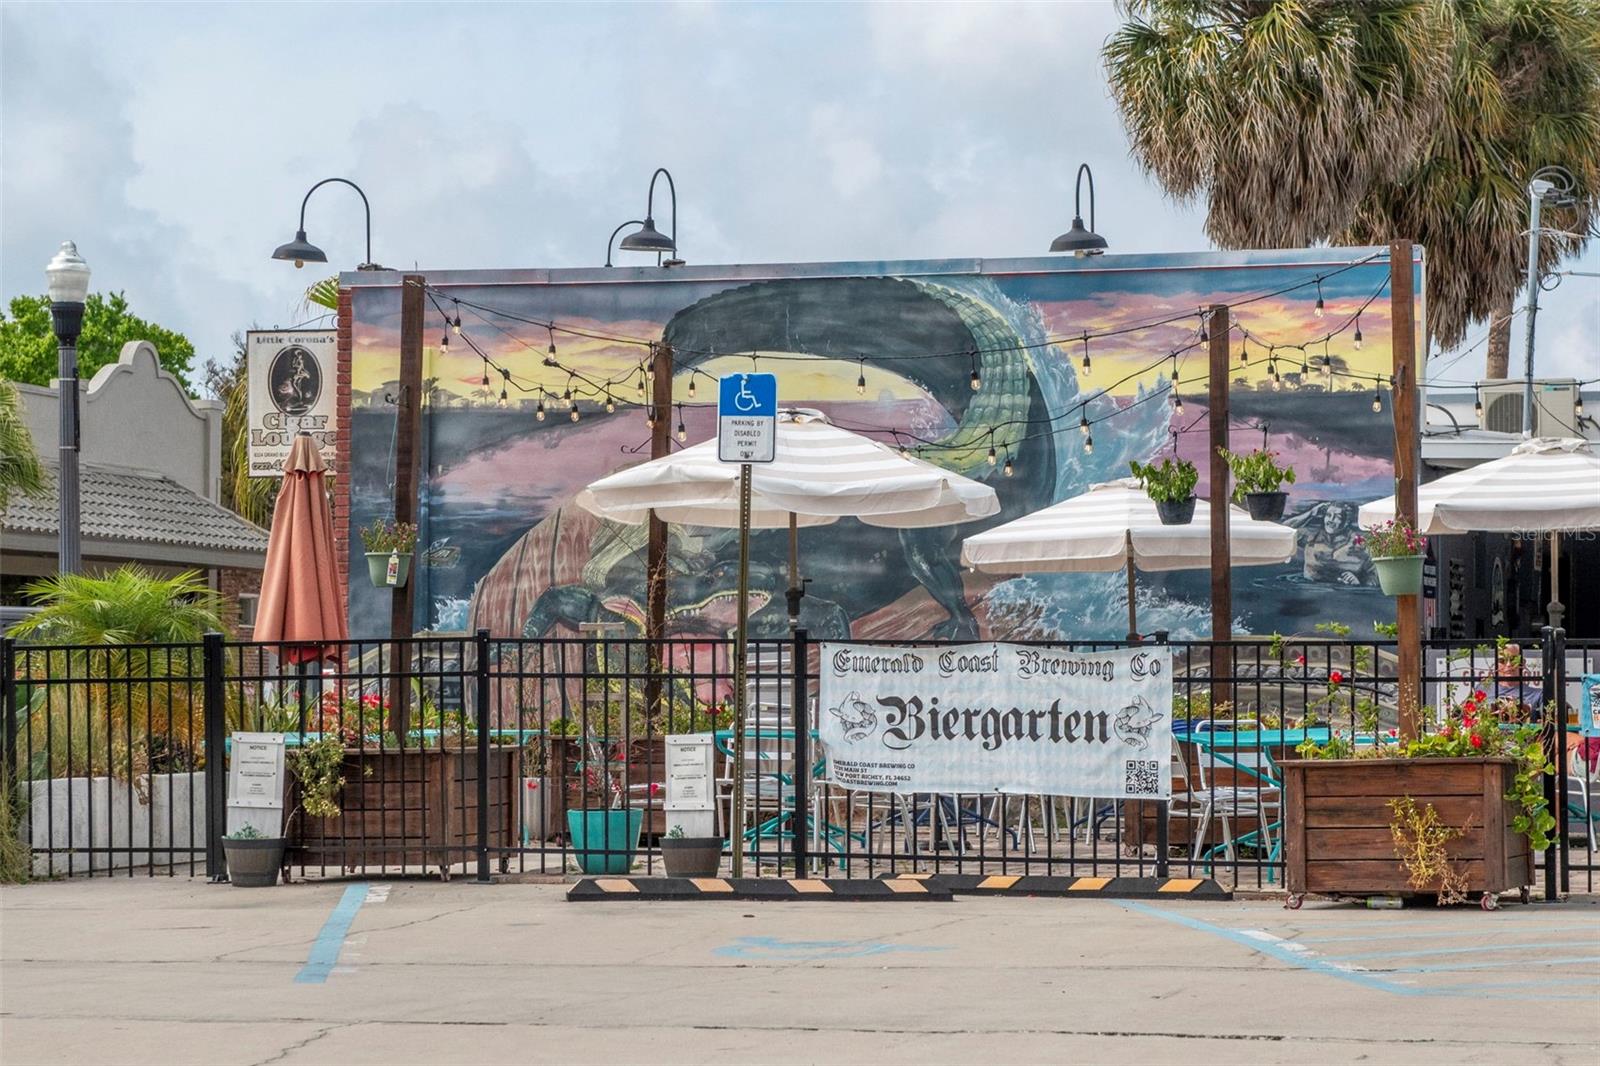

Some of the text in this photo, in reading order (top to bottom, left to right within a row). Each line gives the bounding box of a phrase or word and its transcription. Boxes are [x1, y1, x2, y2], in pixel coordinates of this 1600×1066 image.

[256, 335, 335, 344] Little Corona's
[262, 412, 328, 434] Cigar
[251, 429, 337, 451] Louge
[833, 649, 1162, 682] Emerald Coast Brewing Co
[876, 695, 1111, 751] Biergarten
